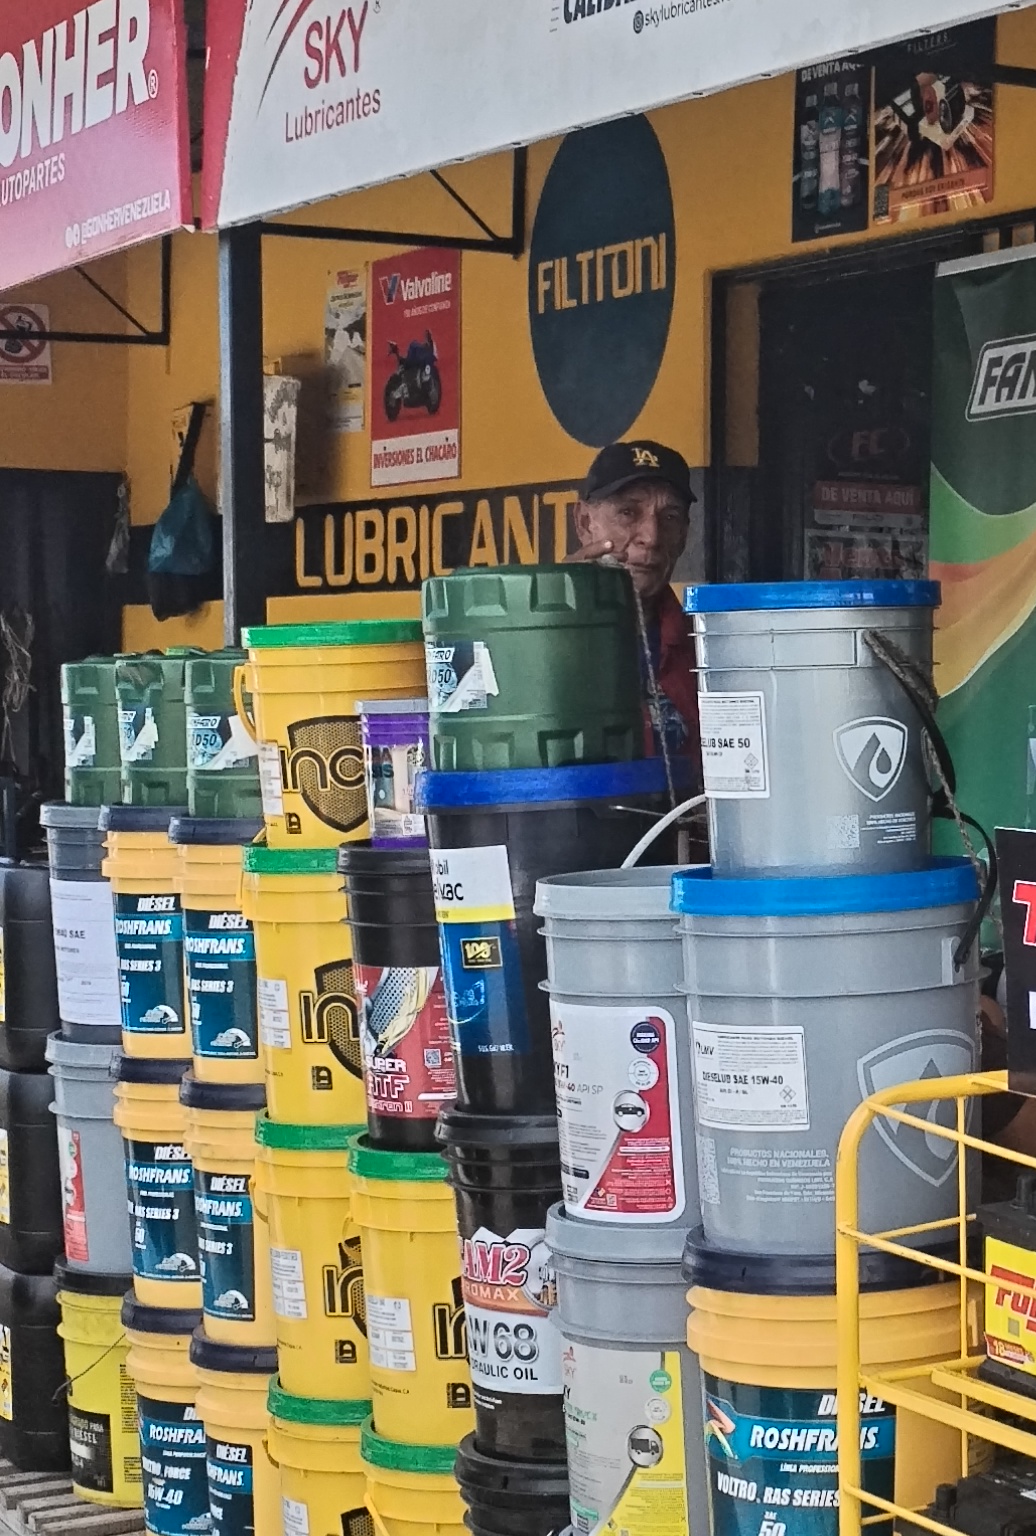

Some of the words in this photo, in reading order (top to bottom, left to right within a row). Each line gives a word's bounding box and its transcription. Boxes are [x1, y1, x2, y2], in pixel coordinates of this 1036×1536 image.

[303, 0, 369, 90] SKY
[284, 85, 382, 146] Lubricantes
[400, 270, 452, 303] Valvoline
[373, 447, 415, 470] INVERSIONES
[416, 447, 425, 465] EL
[424, 441, 457, 463] CHACARO
[821, 486, 838, 501] DE
[841, 488, 881, 504] VENTA
[717, 737, 735, 749] SAE
[737, 737, 751, 749] 50
[69, 929, 86, 940] SAE
[154, 959, 162, 972] 3
[226, 980, 234, 994] 3
[732, 1072, 749, 1085] SAE
[751, 1075, 784, 1085] 15W-40
[172, 1208, 180, 1220] 3
[226, 1243, 234, 1255] 3
[493, 1322, 538, 1362] 68
[513, 1366, 539, 1381] OIL
[763, 1486, 791, 1506] RAS
[791, 1488, 842, 1508] SERIES
